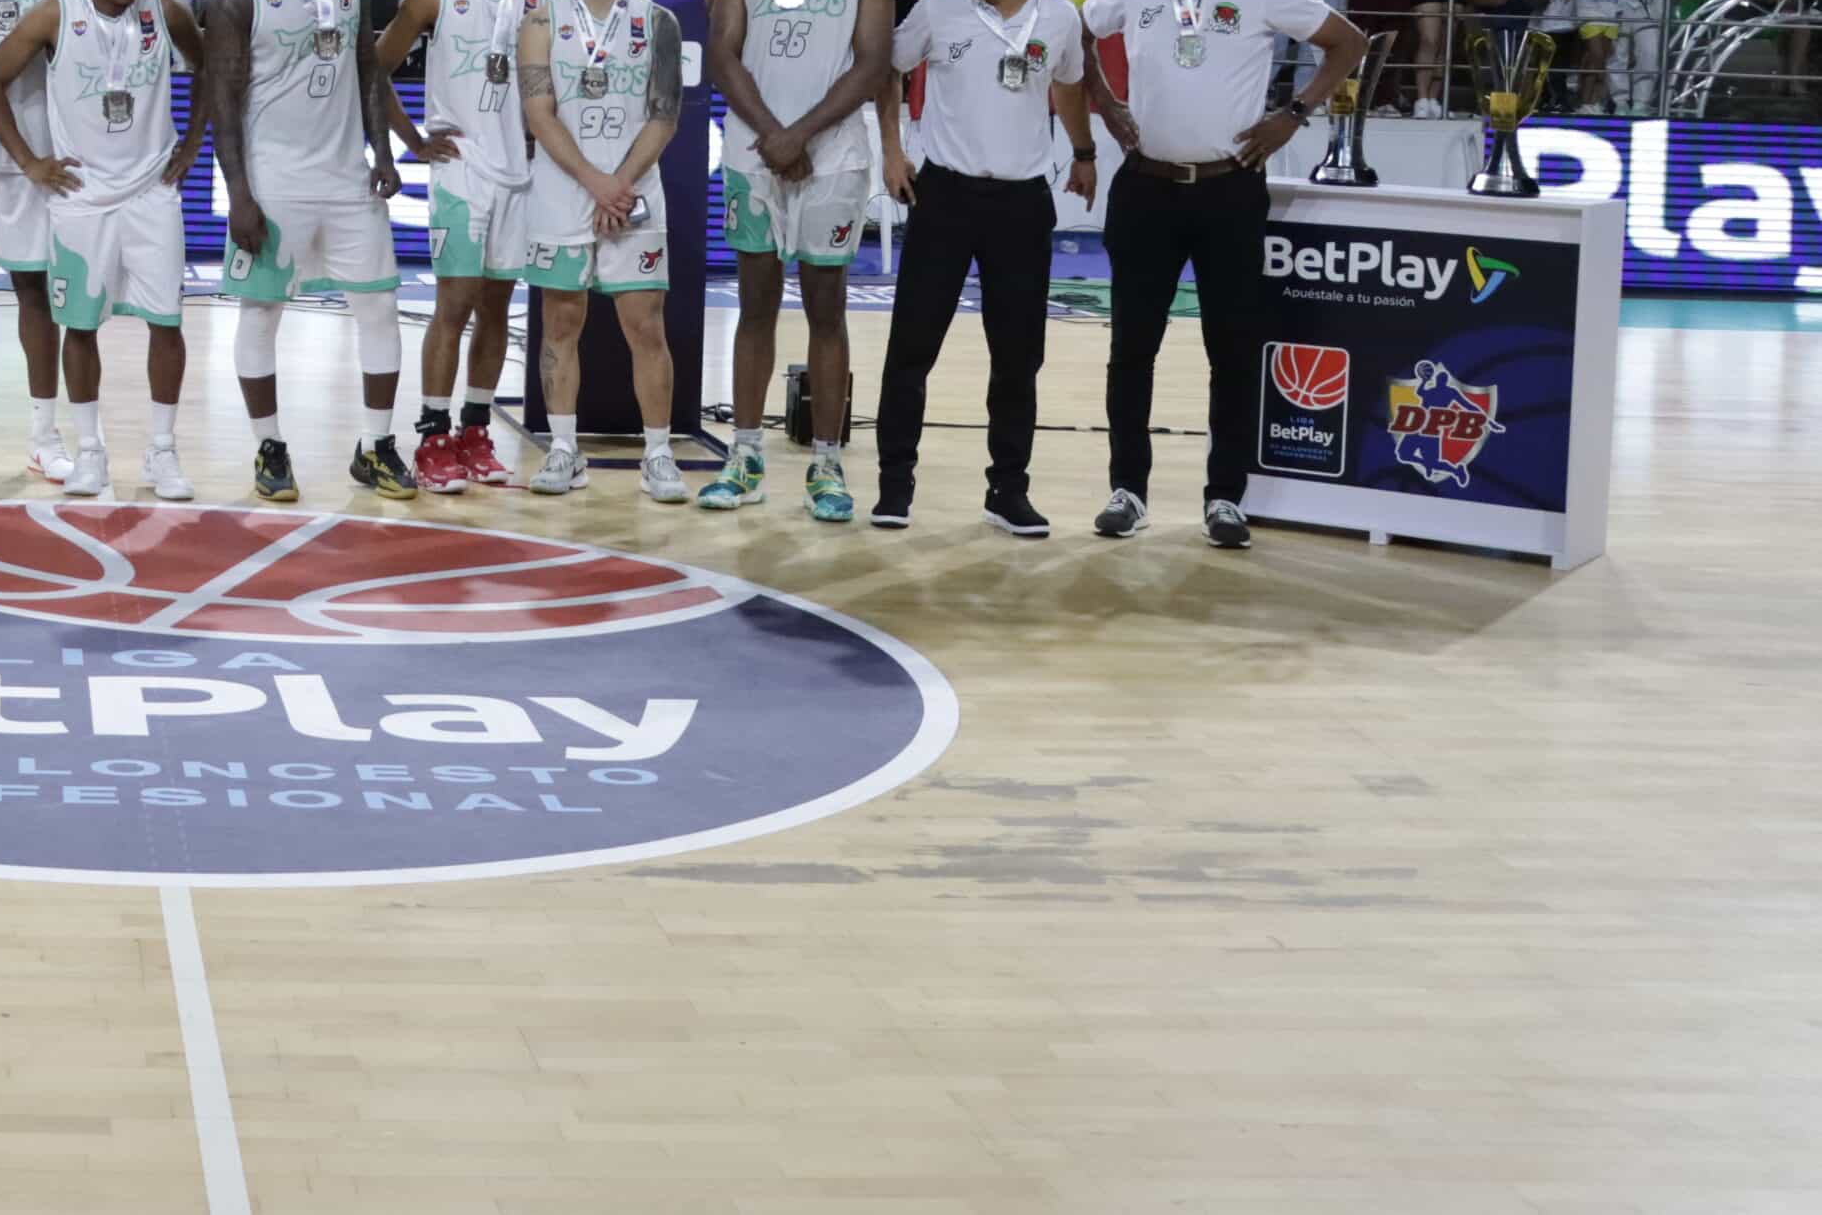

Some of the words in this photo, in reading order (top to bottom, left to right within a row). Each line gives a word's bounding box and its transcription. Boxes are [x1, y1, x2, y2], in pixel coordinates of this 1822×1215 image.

[769, 18, 812, 58] 26
[307, 63, 336, 98] 0
[579, 105, 627, 139] 92
[228, 247, 255, 282] 0
[1262, 236, 1459, 300] BetPlay
[52, 276, 67, 308] 5
[1282, 286, 1344, 302] Apuéstale
[1346, 293, 1354, 302] a
[1358, 293, 1370, 304] tu
[1373, 294, 1415, 307] pasión
[1270, 423, 1334, 447] BetPlay
[1387, 405, 1487, 440] DPB
